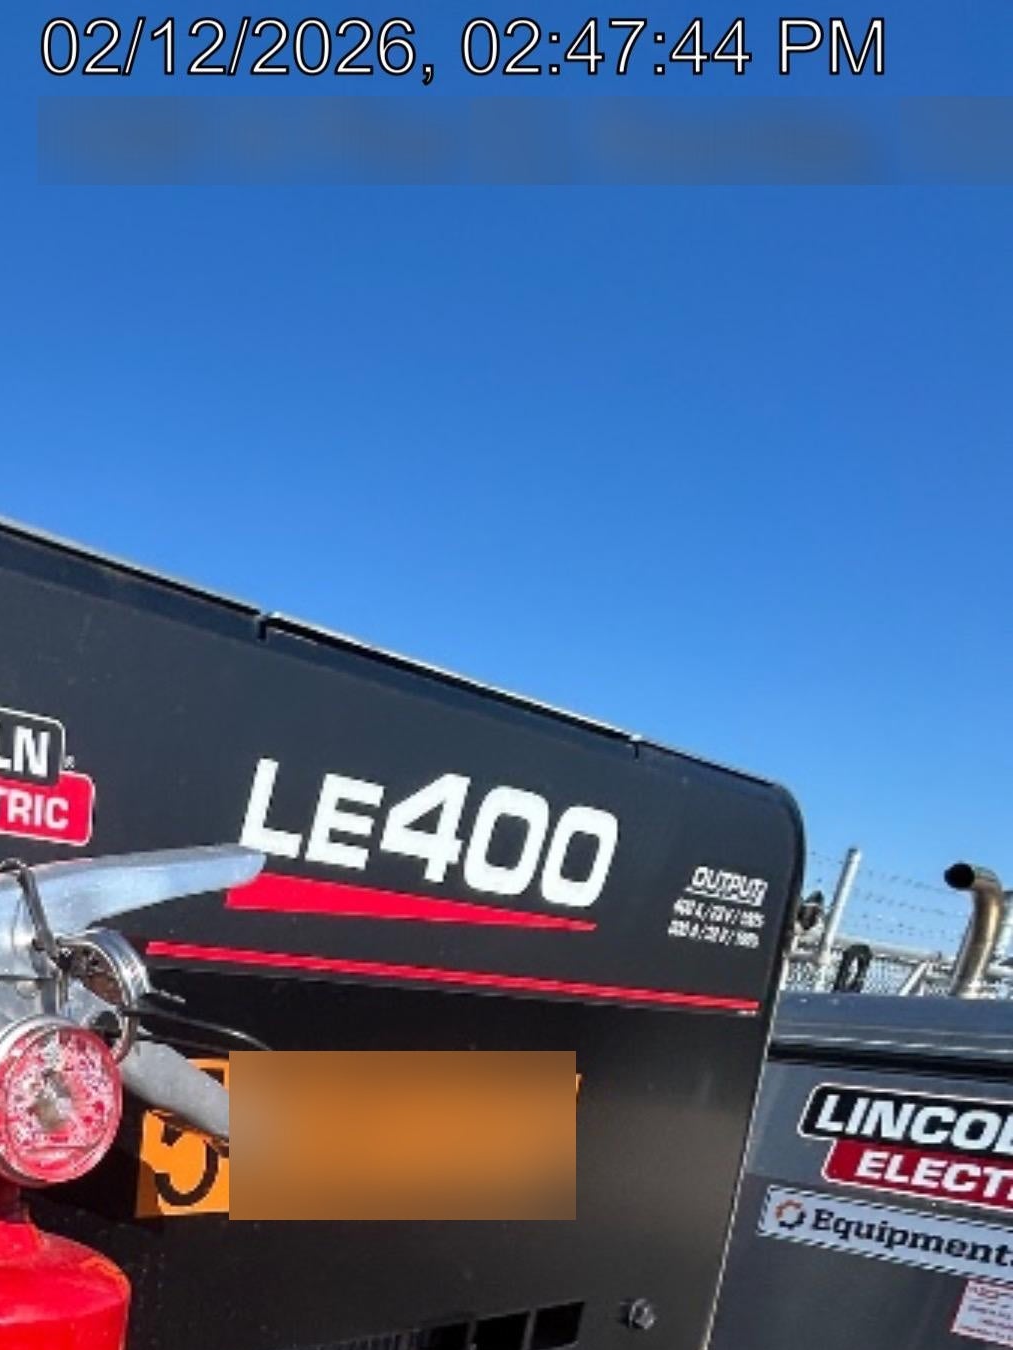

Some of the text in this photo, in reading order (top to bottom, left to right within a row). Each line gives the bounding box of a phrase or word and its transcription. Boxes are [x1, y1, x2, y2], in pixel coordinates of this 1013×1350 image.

[240, 757, 619, 908] LE400
[855, 1149, 1013, 1203] ELECT
[811, 1208, 1013, 1268] Equipment
